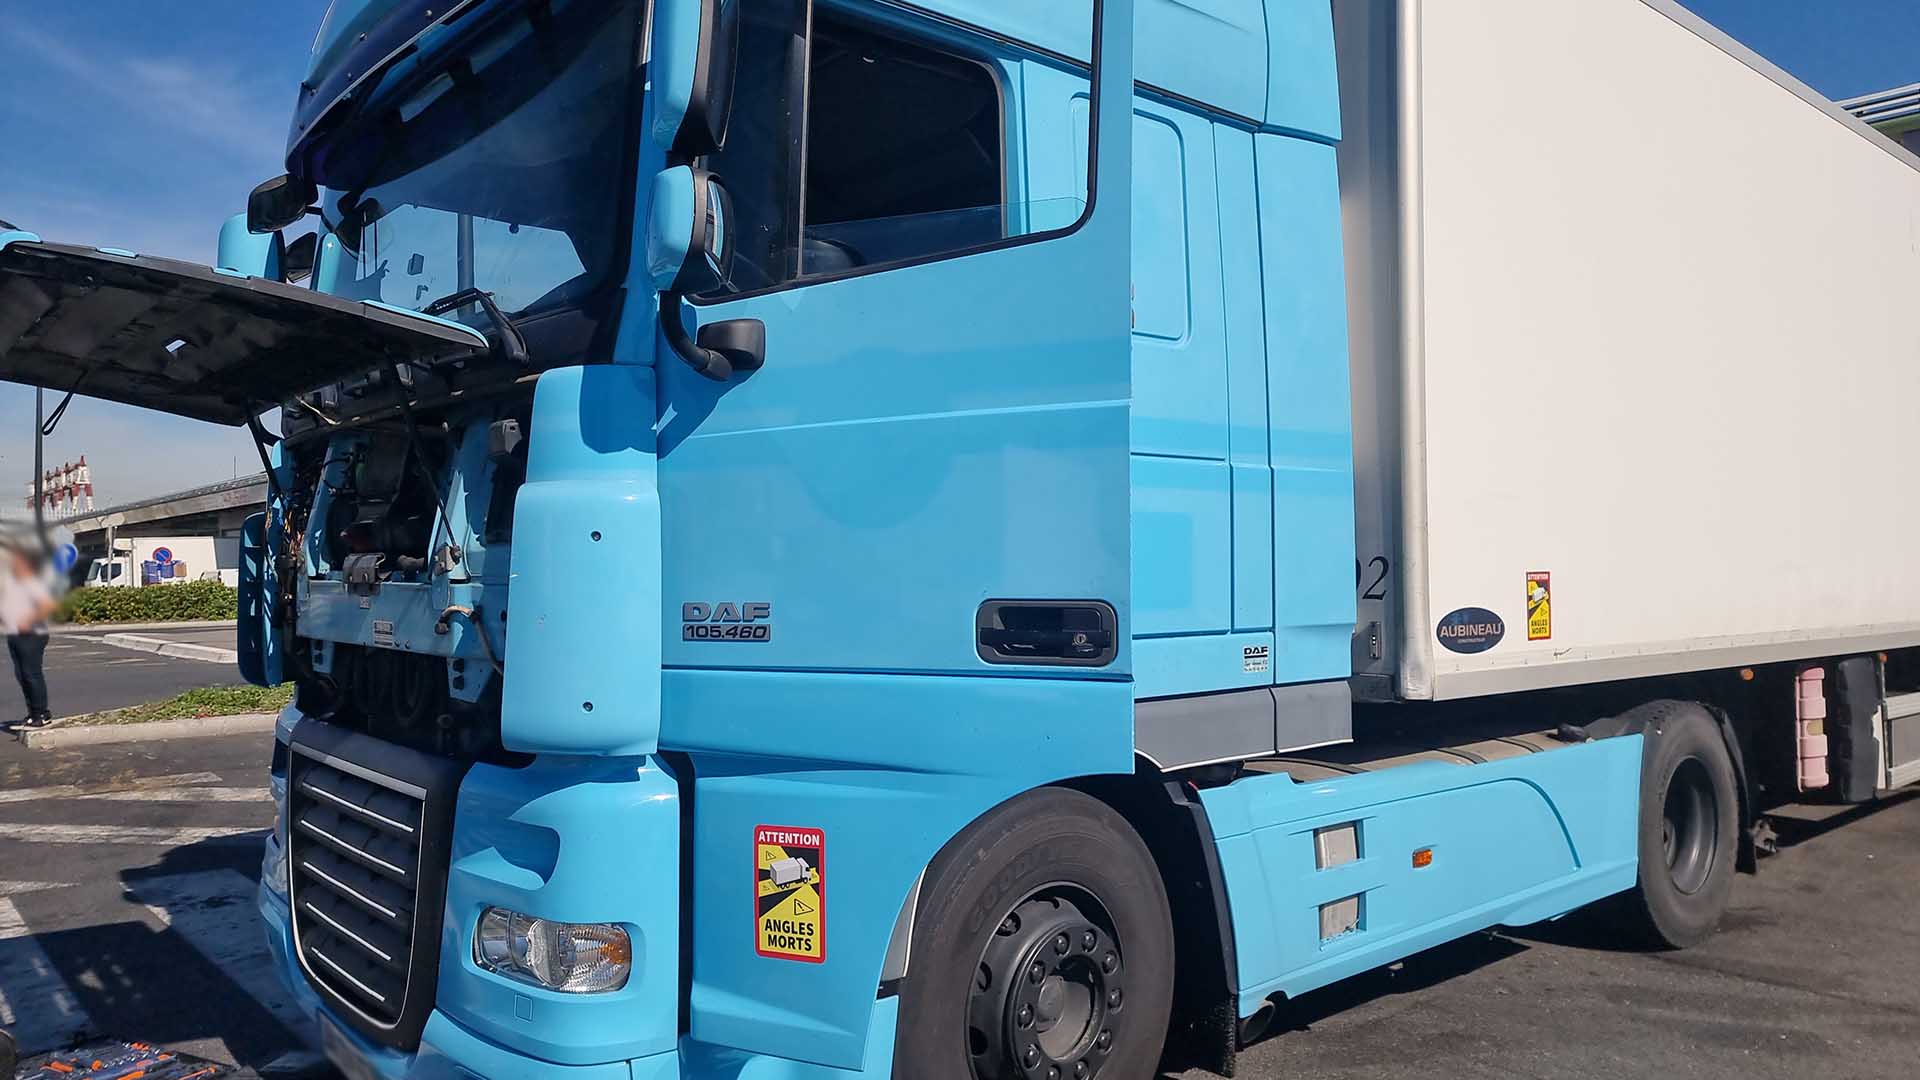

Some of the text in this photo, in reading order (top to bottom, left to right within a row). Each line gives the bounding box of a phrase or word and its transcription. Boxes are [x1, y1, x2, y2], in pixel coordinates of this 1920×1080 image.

[1356, 556, 1389, 600] 2
[682, 602, 771, 622] DAF
[686, 625, 767, 639] 105.460
[1440, 623, 1502, 638] AUBINEAU
[1244, 646, 1268, 655] DAF
[758, 831, 820, 846] ATTENTION
[765, 918, 814, 936] ANGLES
[767, 934, 812, 951] MORTS
